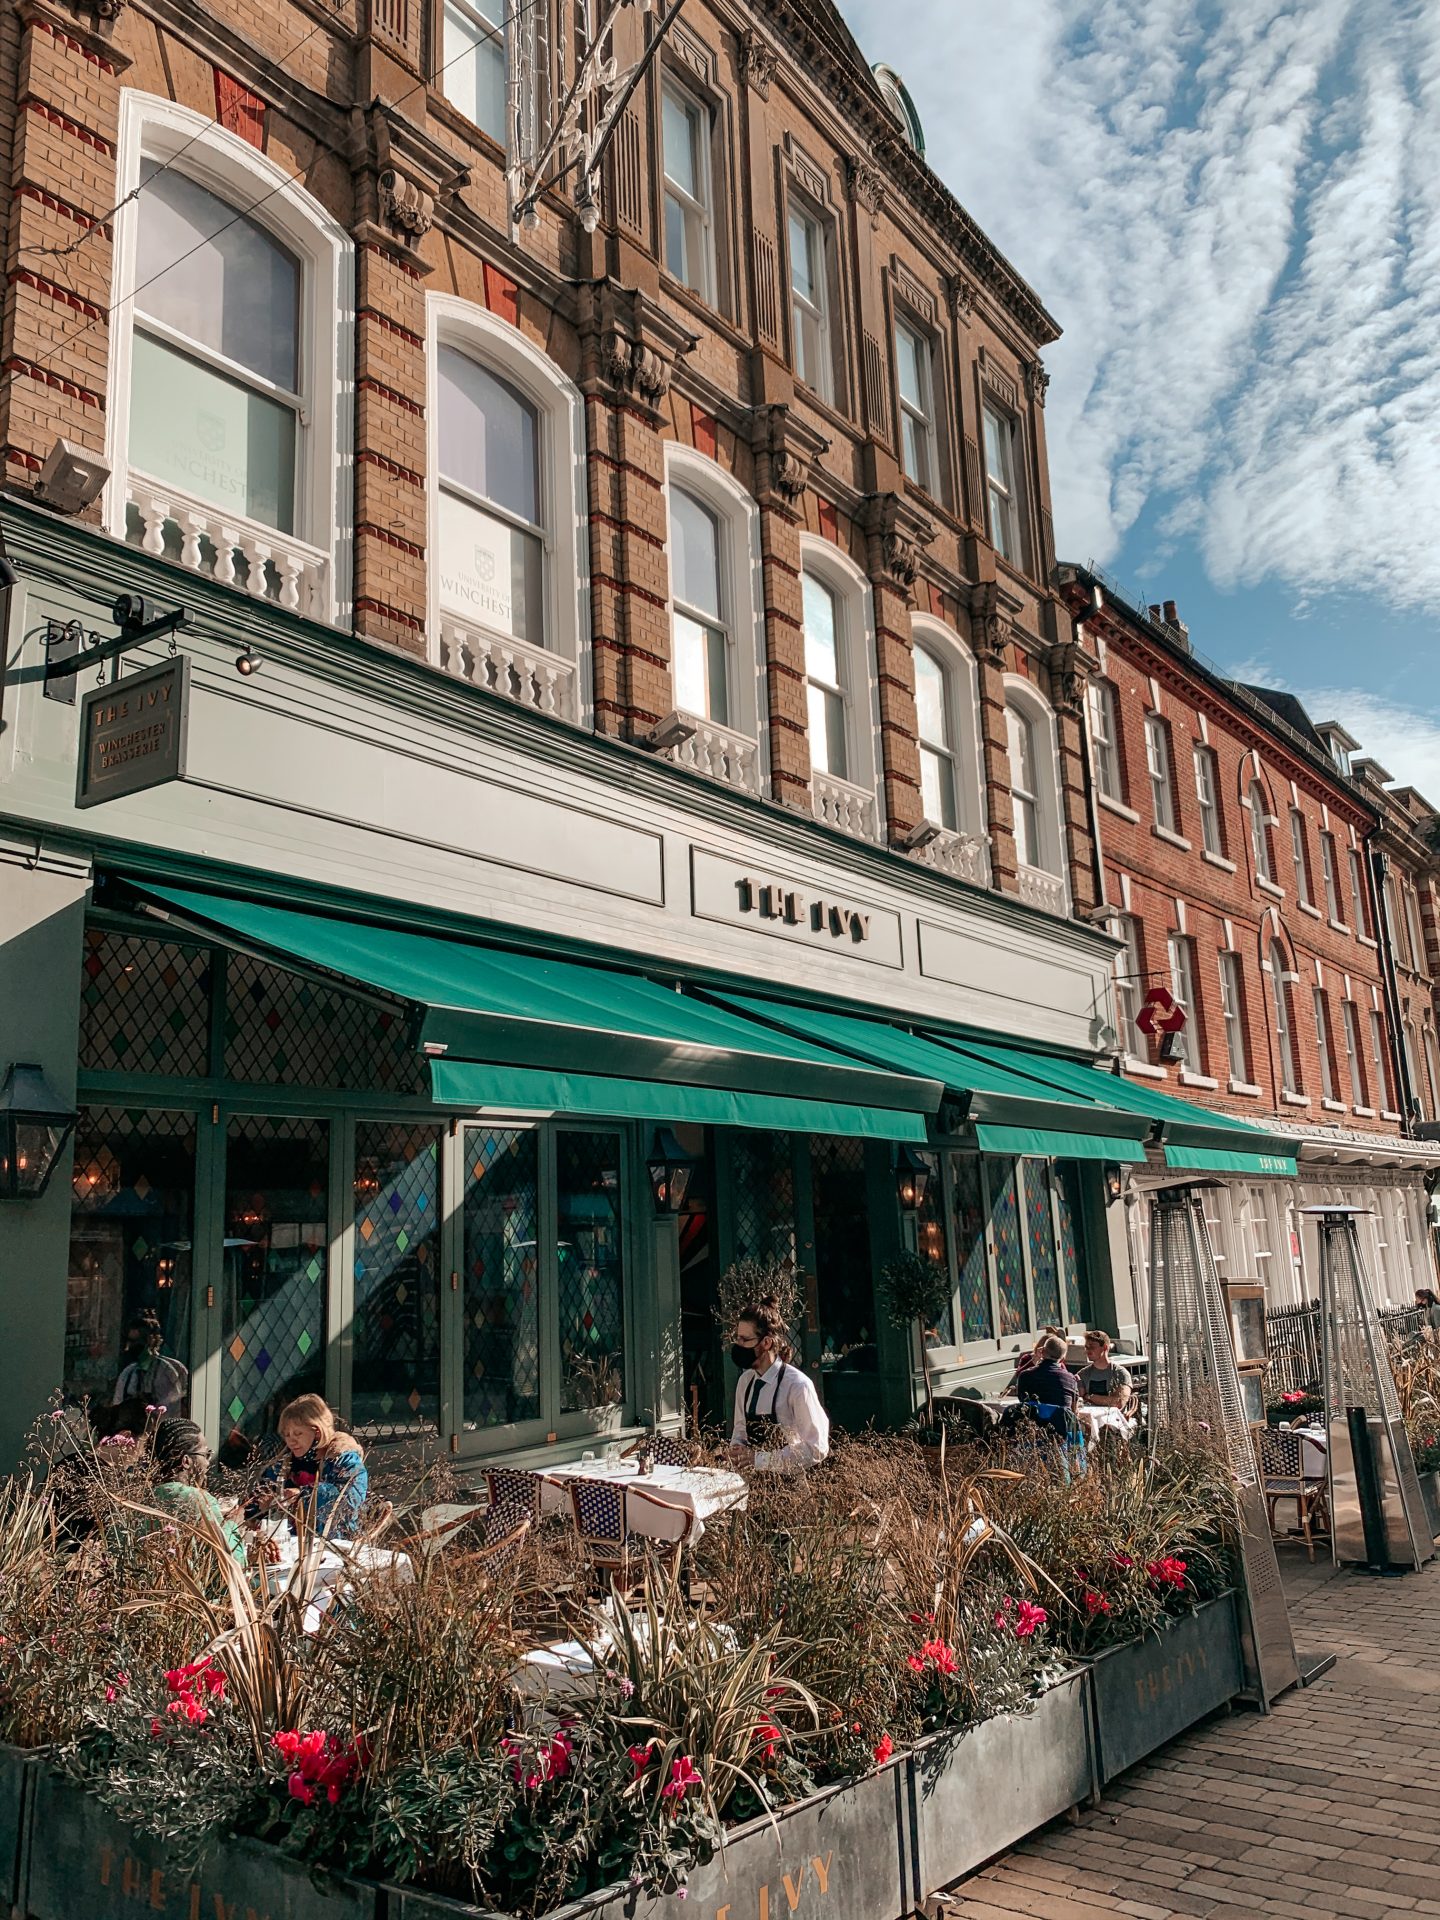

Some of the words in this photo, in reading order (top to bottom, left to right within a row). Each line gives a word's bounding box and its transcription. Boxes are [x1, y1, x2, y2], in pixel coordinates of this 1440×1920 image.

[440, 574, 511, 619] WINCHEST
[95, 701, 129, 726] THE
[138, 684, 173, 712] IVY
[99, 722, 166, 754] WINCHESTER
[101, 738, 161, 768] BRASSERIE
[741, 877, 806, 922] THE
[816, 900, 872, 941] IVY
[1135, 1665, 1172, 1711] THE
[1177, 1646, 1208, 1685] IVY
[98, 1847, 166, 1911] THE
[189, 1883, 270, 1920] IV
[759, 1849, 833, 1920] IVY
